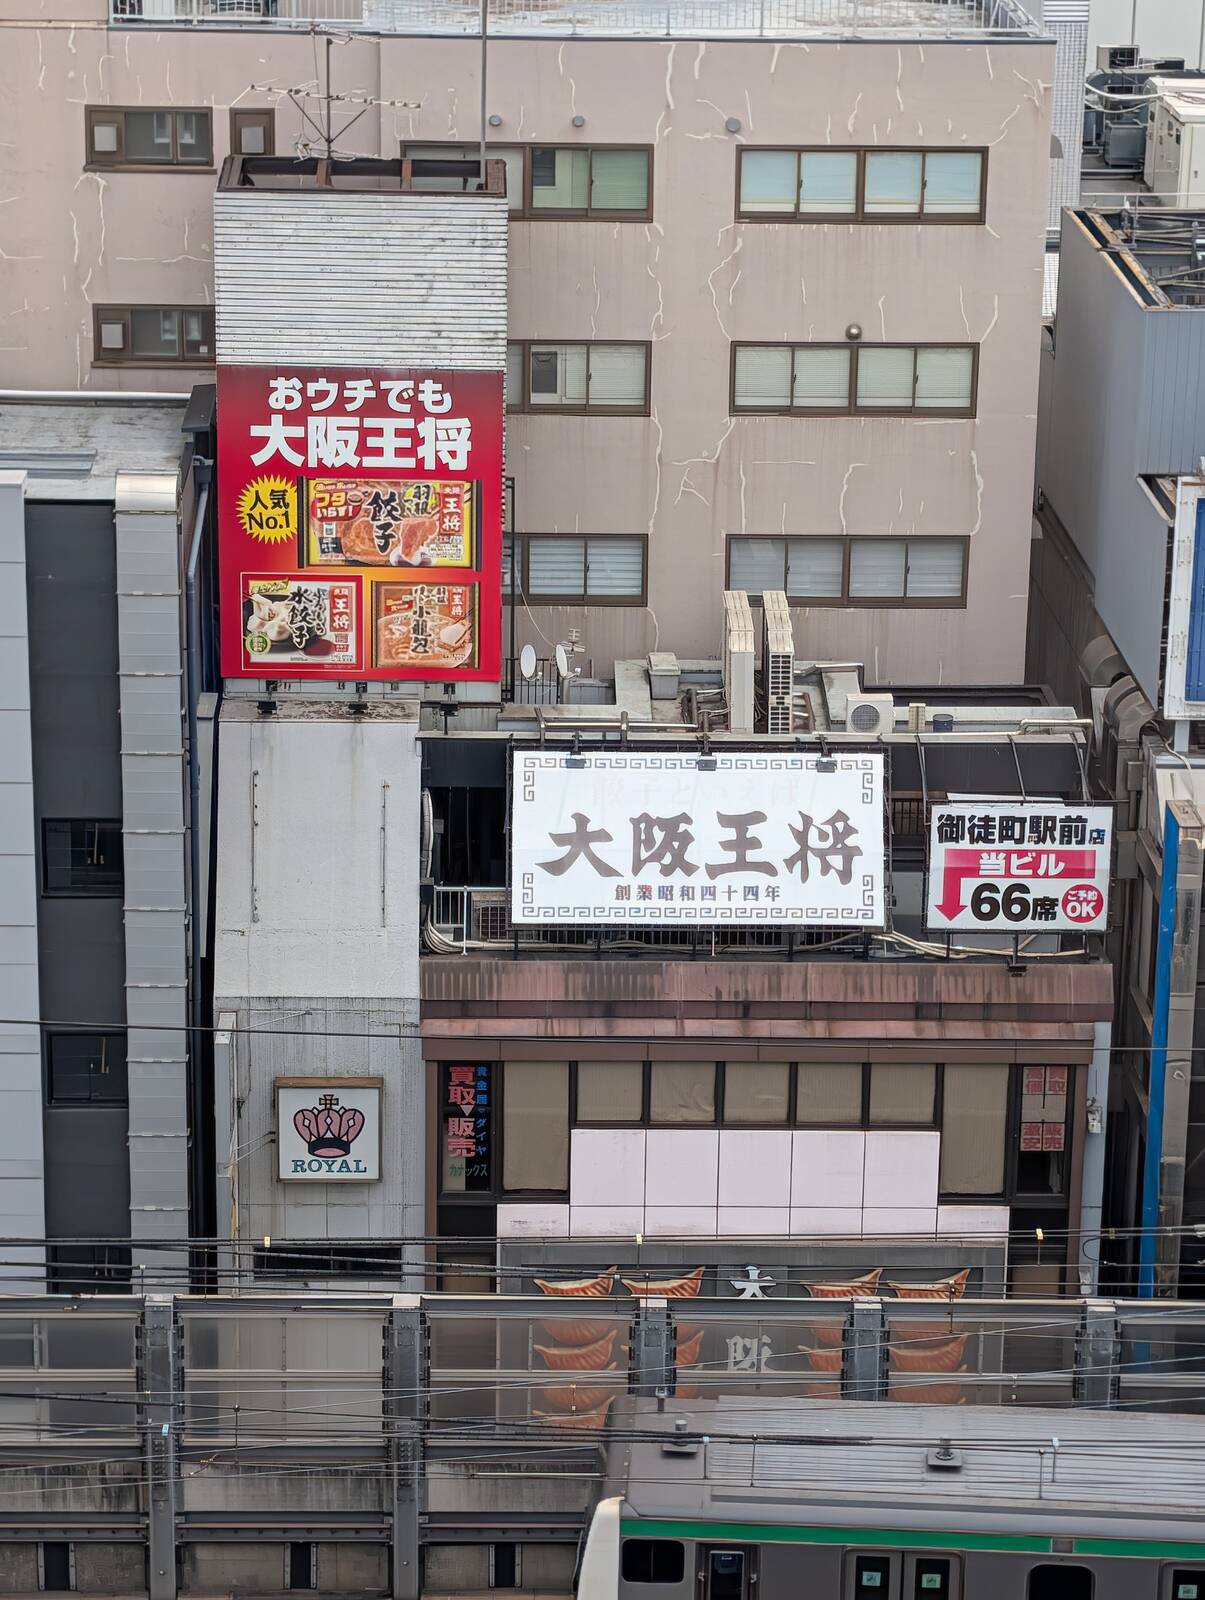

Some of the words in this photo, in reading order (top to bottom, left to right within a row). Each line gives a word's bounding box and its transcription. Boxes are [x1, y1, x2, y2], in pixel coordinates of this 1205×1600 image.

[267, 377, 452, 413] おウチでも
[250, 414, 472, 470] 大阪王将
[249, 489, 290, 511] 人気
[247, 510, 290, 530] No.1
[366, 490, 401, 554] 餃子
[937, 814, 1106, 845] 御徒町駅前店
[535, 809, 863, 885] 大阪王将
[979, 852, 1065, 876] 当ビル
[615, 884, 781, 902] 創業昭和四十四年
[970, 882, 1059, 922] 66席
[1066, 901, 1096, 918] OK
[448, 1066, 476, 1105] 買取
[448, 1117, 476, 1158] 販売
[291, 1159, 367, 1173] ROYAL
